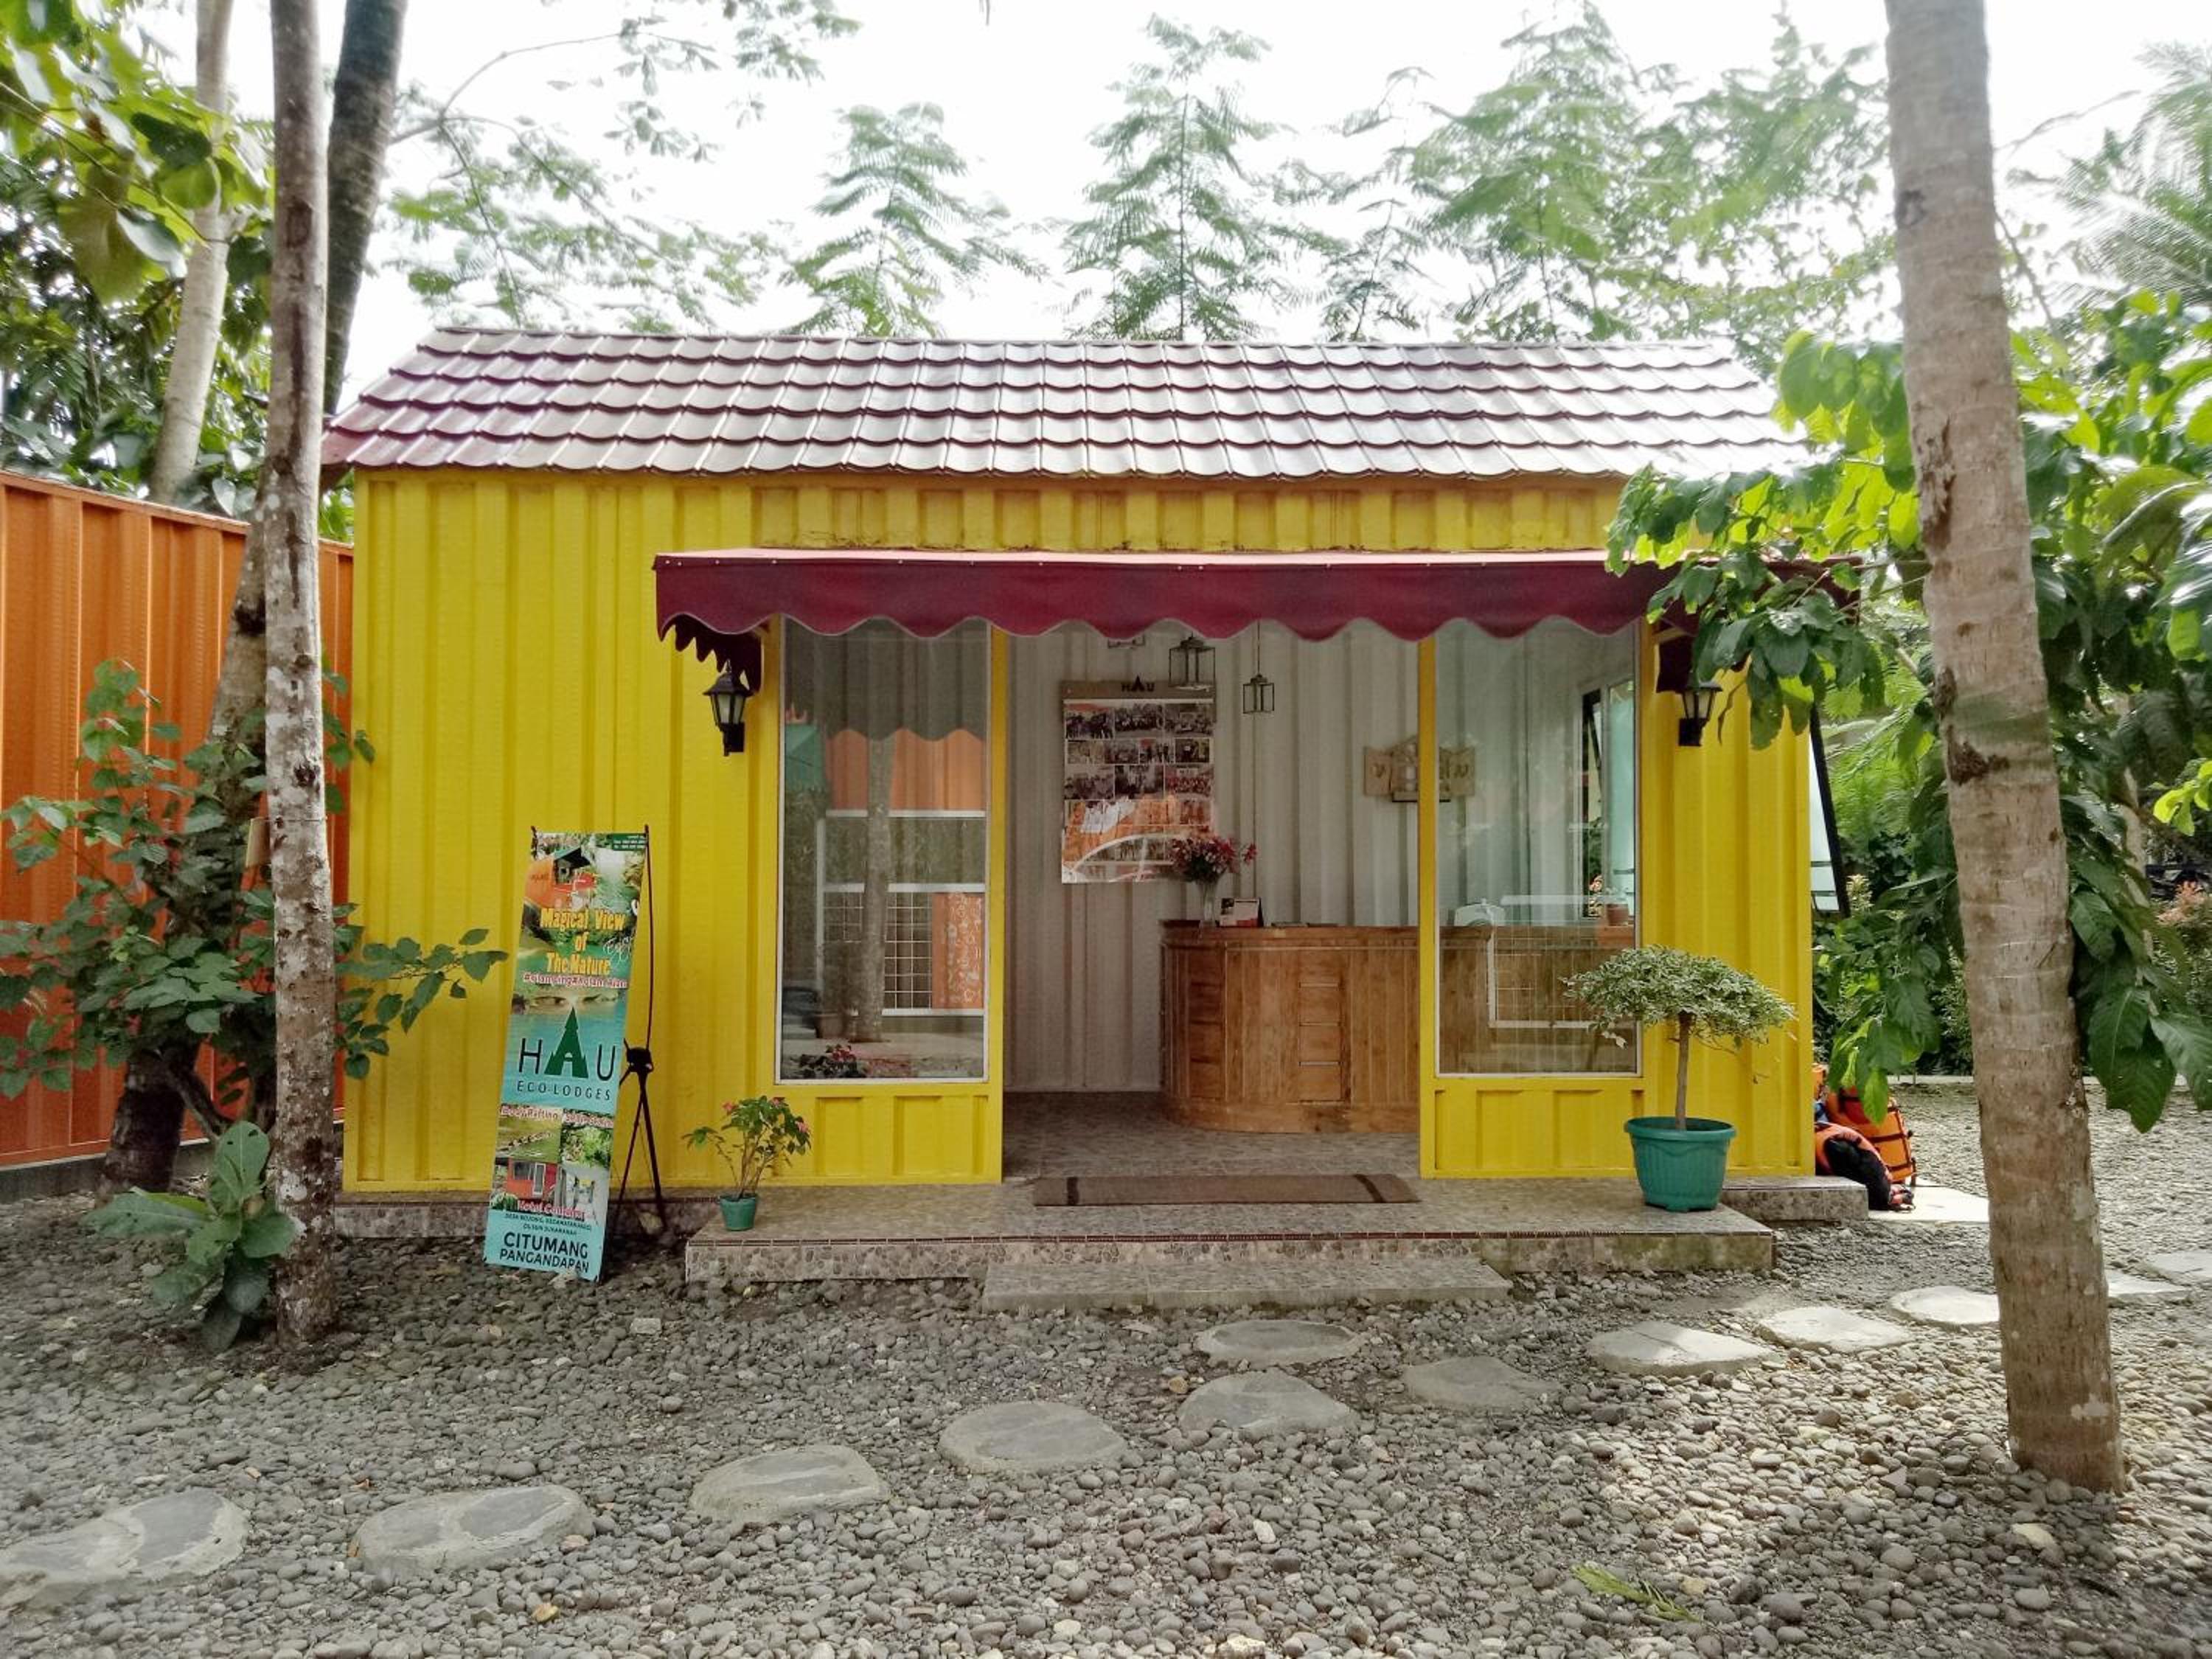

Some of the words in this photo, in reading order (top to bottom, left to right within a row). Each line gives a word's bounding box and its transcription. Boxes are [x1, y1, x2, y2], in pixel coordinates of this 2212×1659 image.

[1121, 675, 1155, 692] HAU
[540, 908, 588, 931] Magical
[595, 910, 625, 931] View
[574, 931, 589, 951] of
[546, 952, 568, 973] The
[570, 953, 611, 975] Nature
[518, 1006, 616, 1082] HAU
[504, 1231, 588, 1259] CITUMANG
